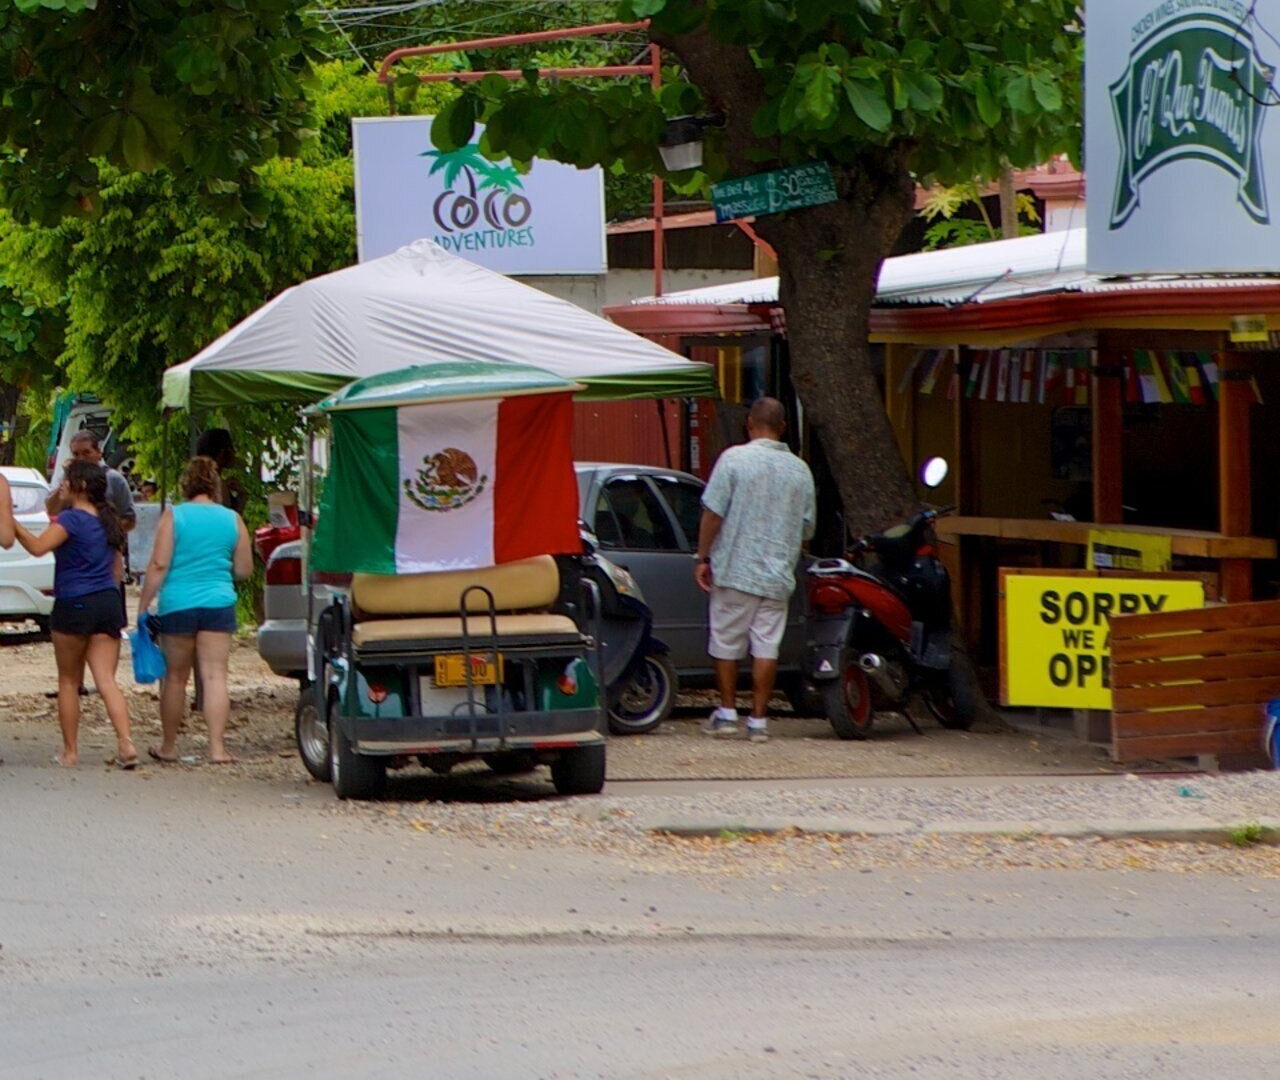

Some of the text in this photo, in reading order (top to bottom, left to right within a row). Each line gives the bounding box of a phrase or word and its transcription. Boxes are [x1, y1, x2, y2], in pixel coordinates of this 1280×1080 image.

[433, 188, 532, 232] COCO
[433, 226, 535, 252] ADVENTURES
[1040, 589, 1168, 625] SORRY
[1062, 629, 1095, 650] WE
